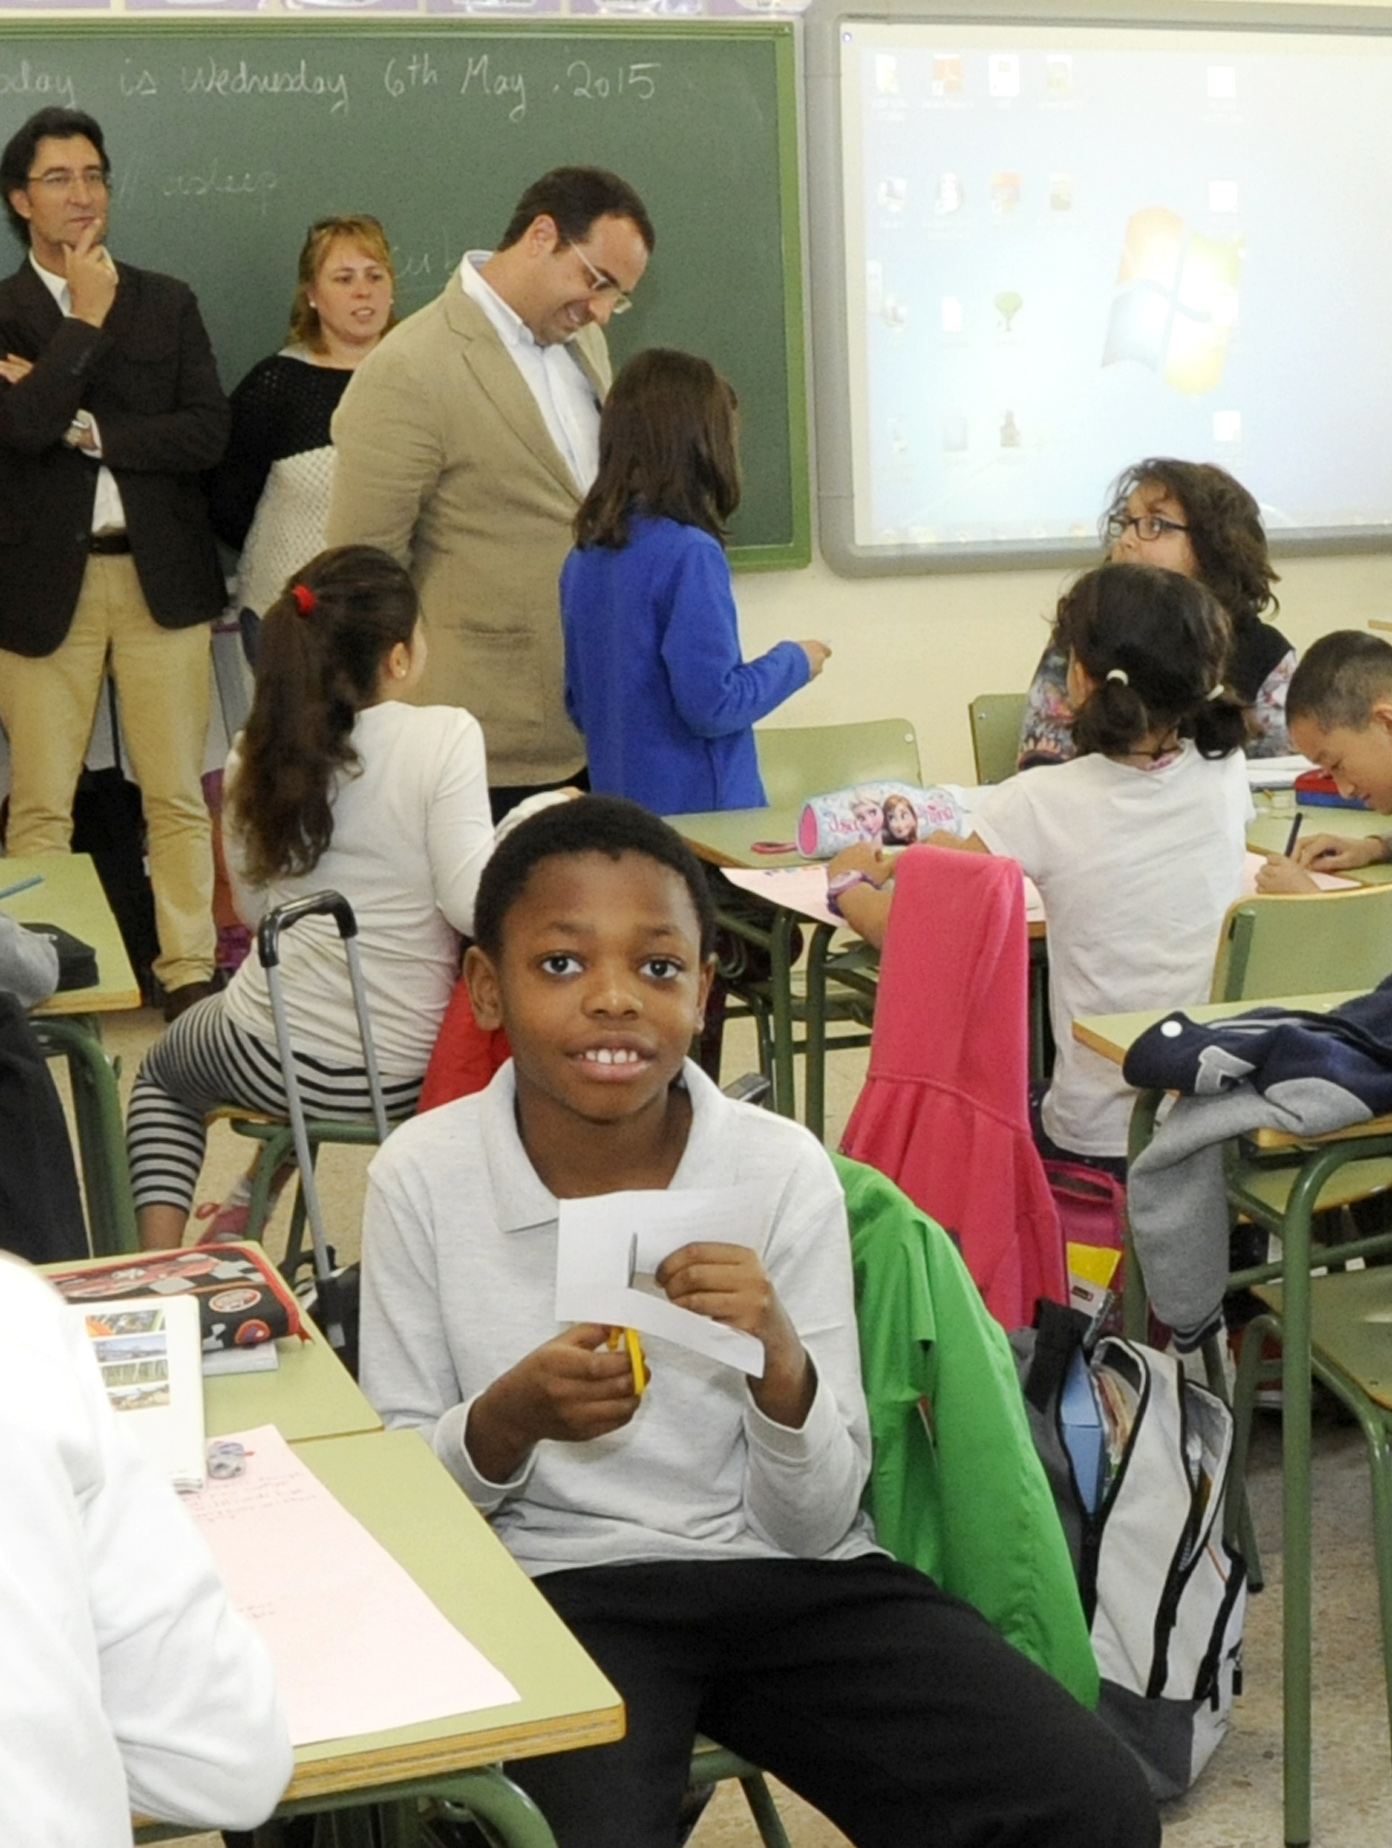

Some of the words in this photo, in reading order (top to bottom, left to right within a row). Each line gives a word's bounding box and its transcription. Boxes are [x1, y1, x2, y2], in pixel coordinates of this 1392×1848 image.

[119, 57, 157, 96] is
[183, 56, 349, 114] Wednesday
[384, 53, 439, 98] 6th
[460, 53, 527, 123] May
